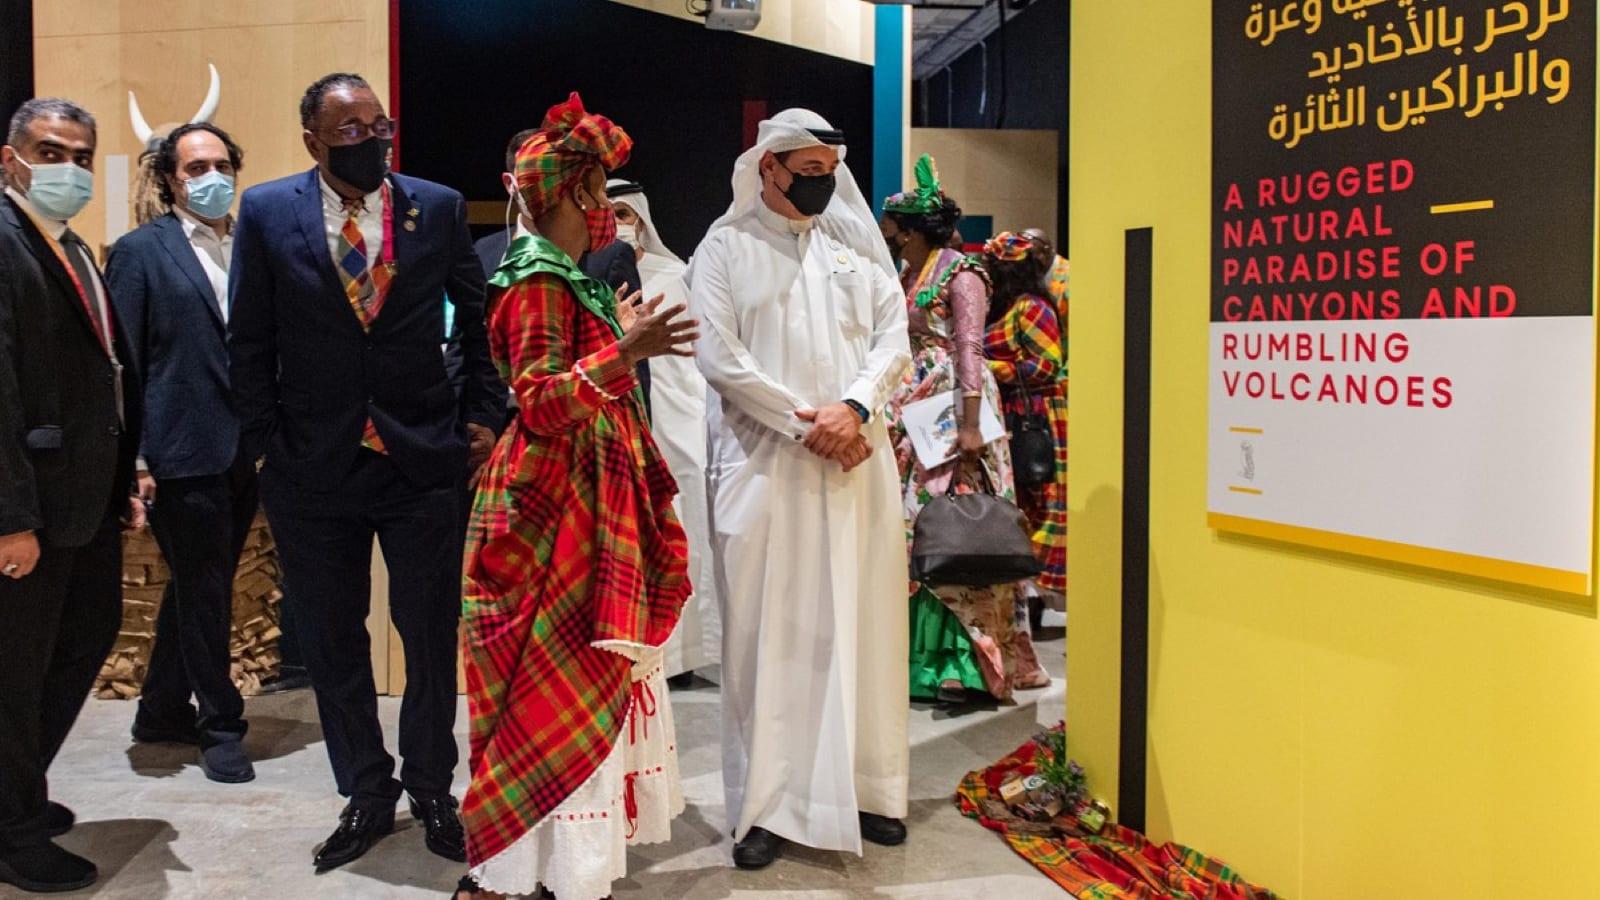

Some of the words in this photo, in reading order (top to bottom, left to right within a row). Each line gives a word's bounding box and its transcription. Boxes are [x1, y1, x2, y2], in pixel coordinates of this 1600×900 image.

[1245, 0, 1322, 47] وعرة
[1308, 6, 1465, 84] بالأخاديد
[1376, 48, 1571, 132] والبراكين
[1268, 85, 1366, 149] الثائرة
[1224, 183, 1244, 212] A
[1258, 158, 1415, 208] RUGGED
[1223, 204, 1393, 249] NATURAL
[1223, 246, 1401, 286] PARADISE
[1419, 239, 1476, 277] OF
[1223, 288, 1401, 323] CANYONS
[1420, 284, 1517, 321] AND
[1222, 332, 1410, 364] RUMBLING
[1222, 371, 1454, 409] VOLCANOES
